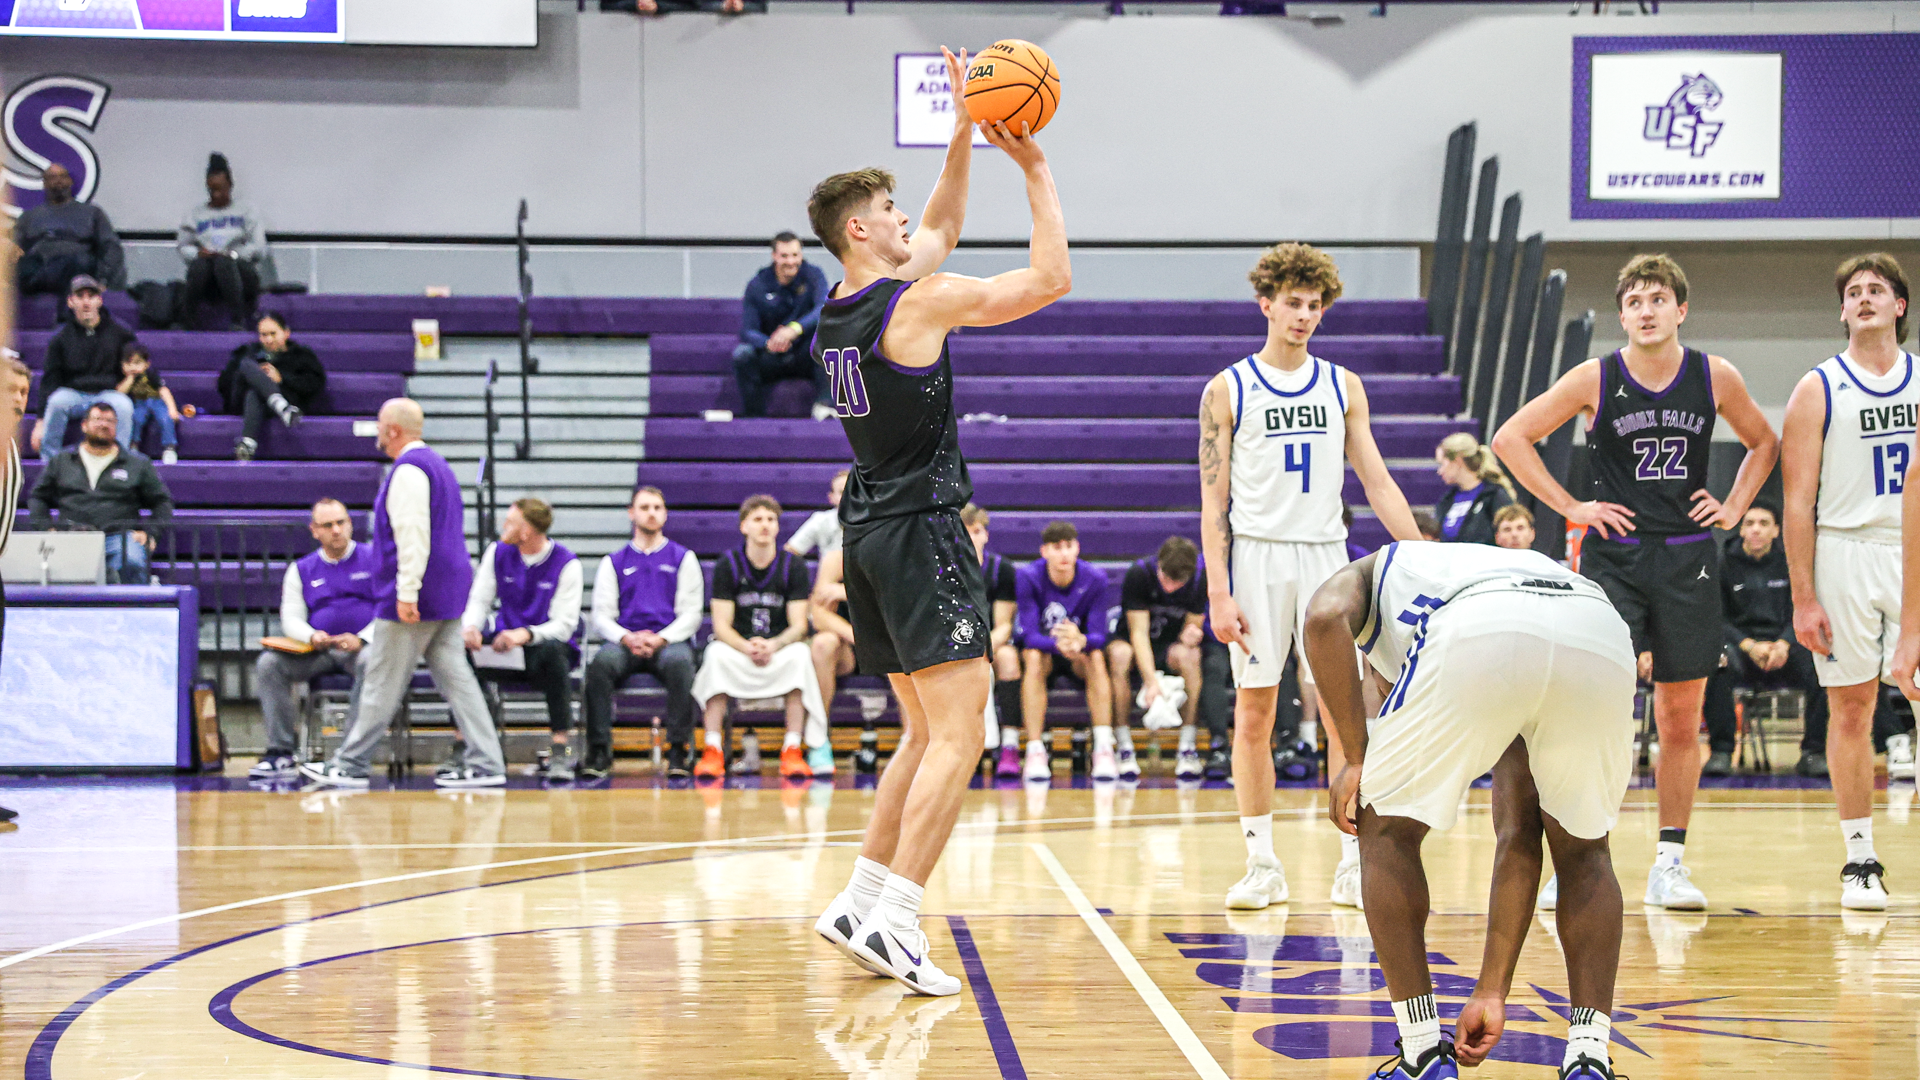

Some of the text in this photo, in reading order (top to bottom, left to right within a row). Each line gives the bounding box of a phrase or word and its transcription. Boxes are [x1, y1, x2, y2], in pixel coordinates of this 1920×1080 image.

[1642, 105, 1724, 158] USF
[1607, 173, 1765, 187] USFCOUGARS.COM
[822, 346, 871, 418] 20
[1265, 405, 1327, 430] GVSU
[1613, 409, 1706, 437] SIOUX FALLS
[1860, 403, 1919, 431] GVSU
[1284, 442, 1311, 493] 4
[1633, 436, 1688, 481] 22
[1873, 442, 1910, 497] 13
